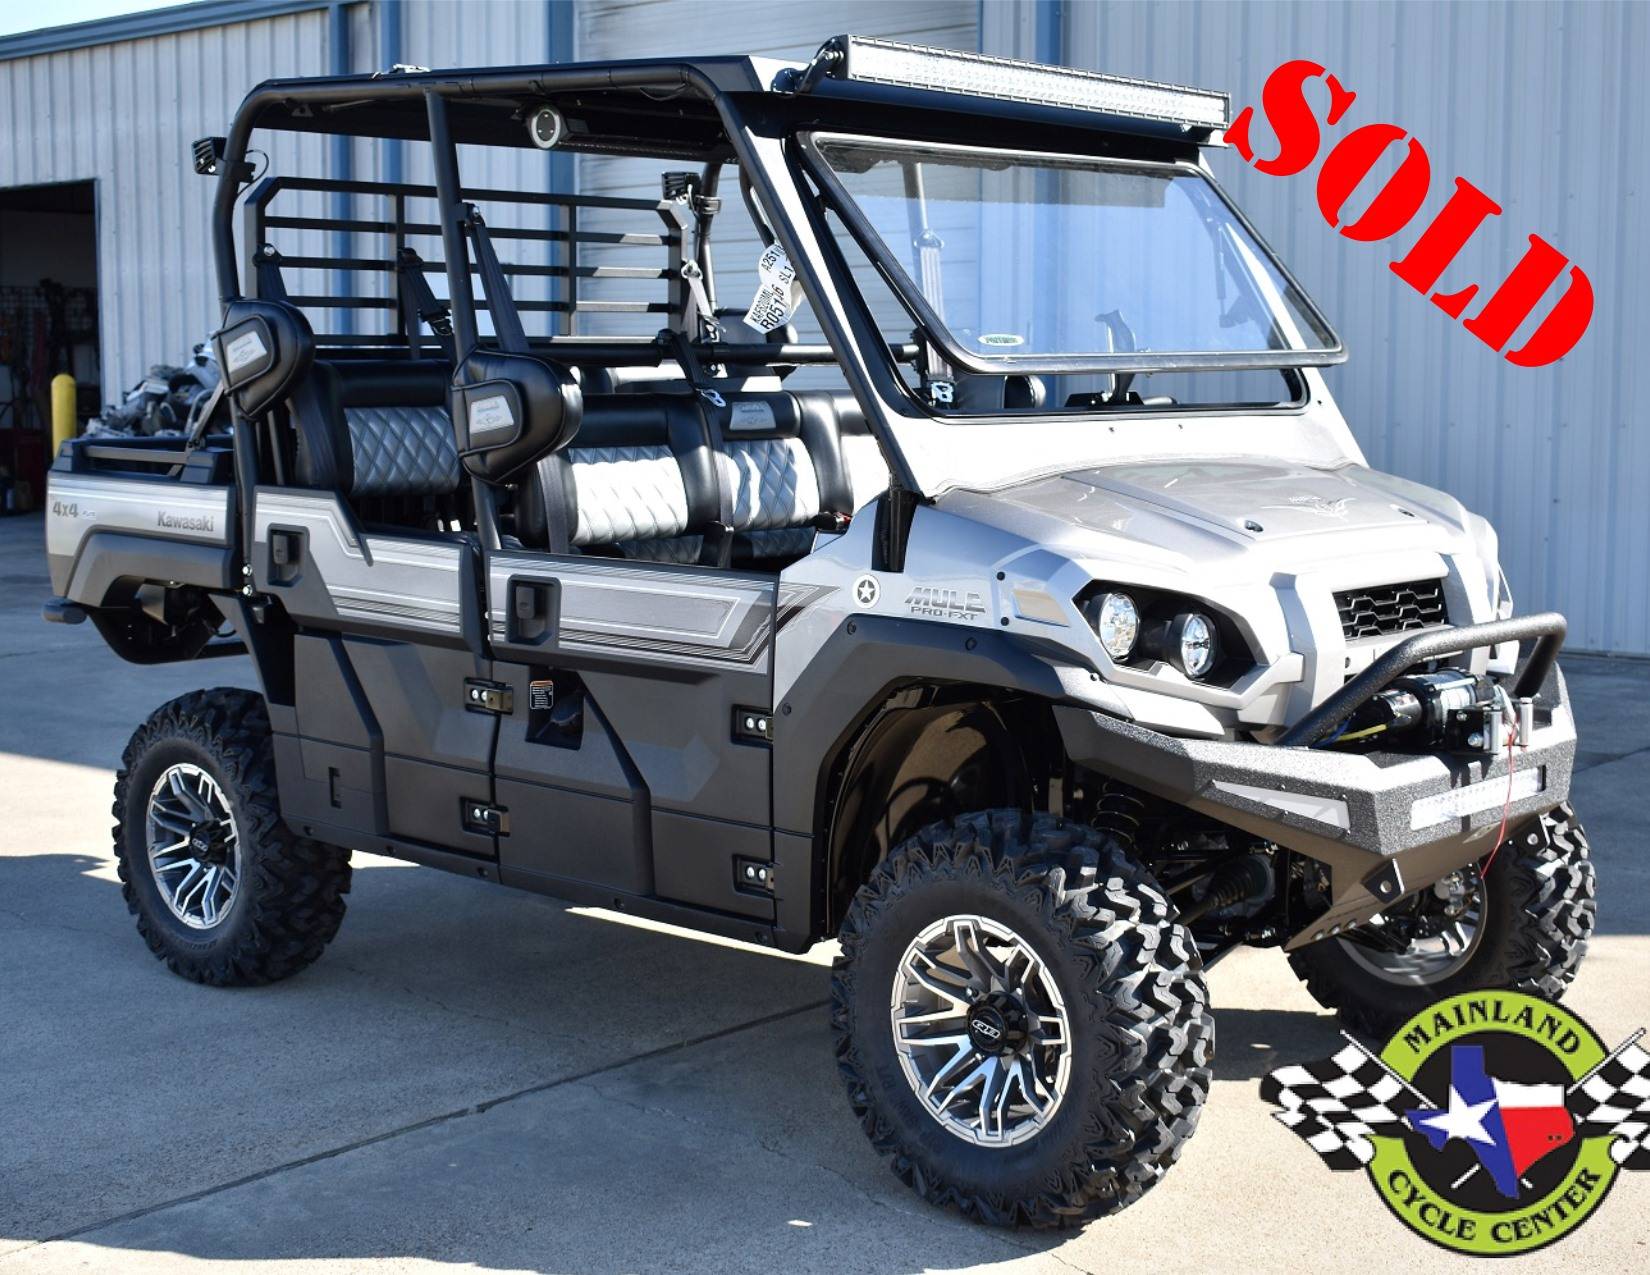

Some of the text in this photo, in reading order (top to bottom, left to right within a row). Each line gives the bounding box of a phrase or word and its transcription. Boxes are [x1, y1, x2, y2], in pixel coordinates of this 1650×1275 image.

[52, 501, 79, 518] 4x4
[157, 511, 214, 532] Kawasaki
[905, 587, 986, 613] MULE
